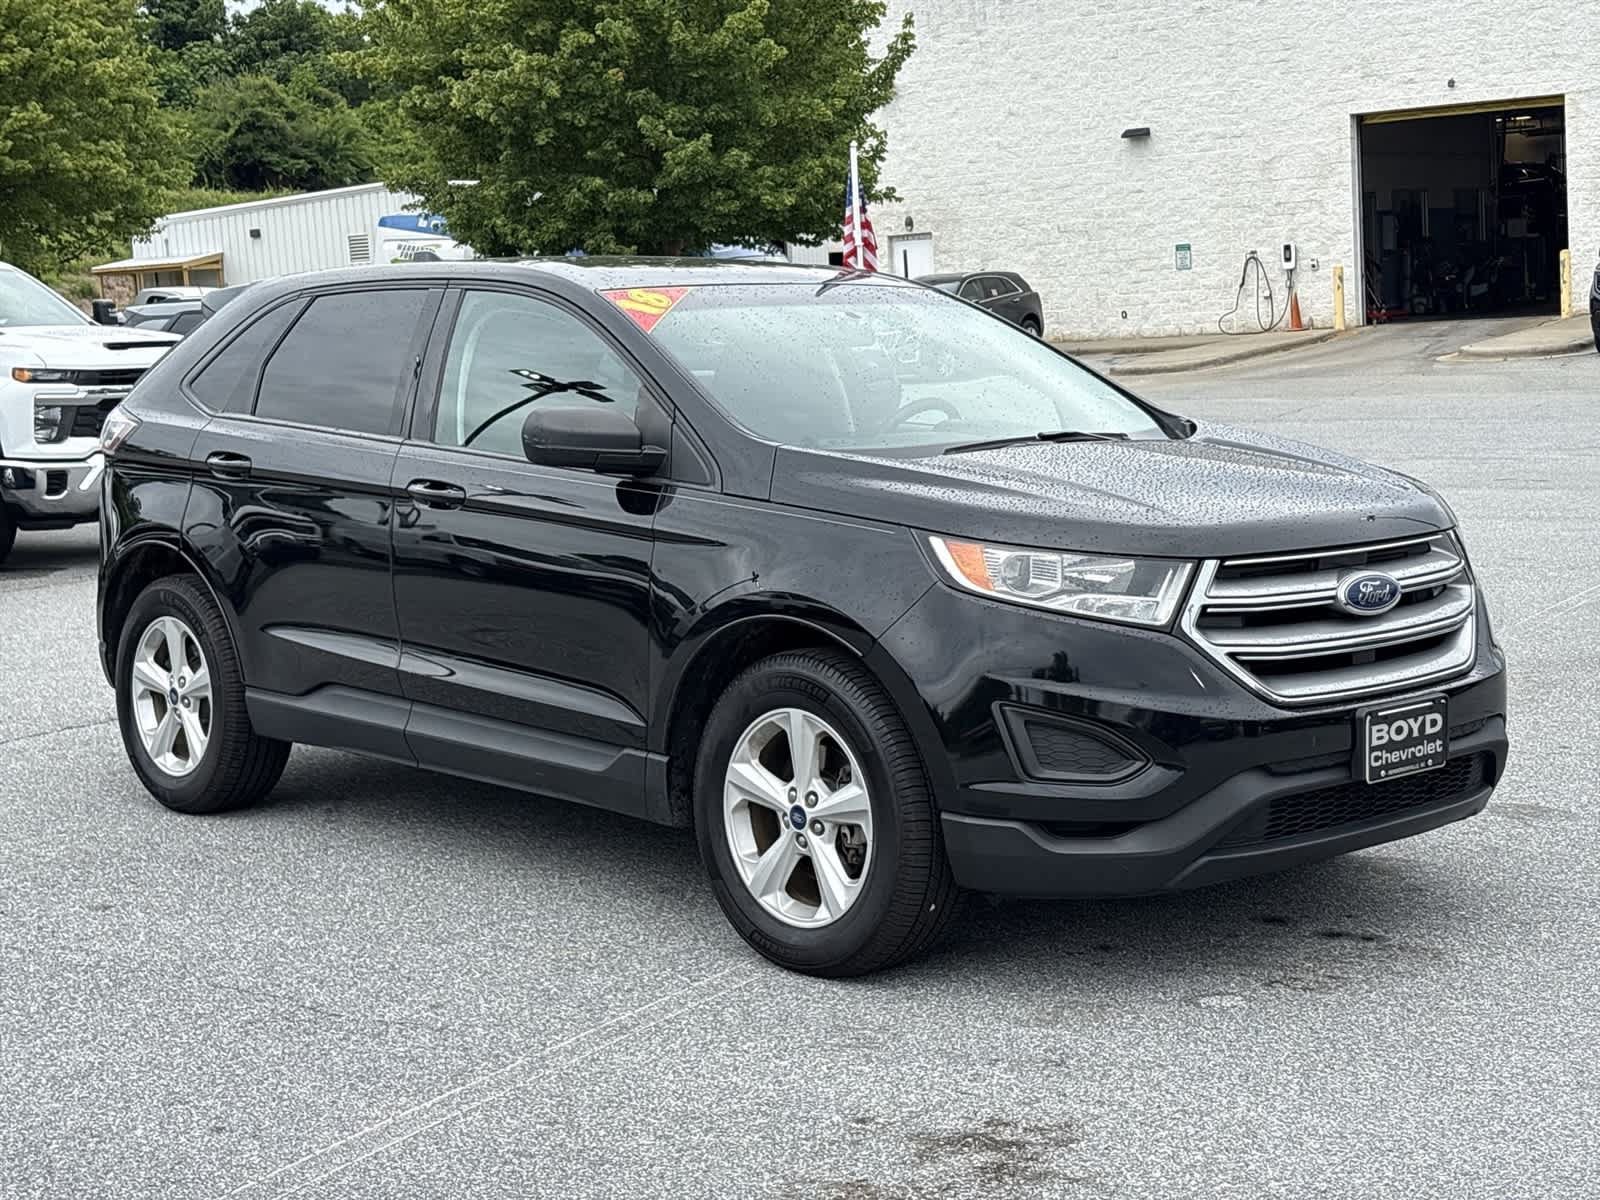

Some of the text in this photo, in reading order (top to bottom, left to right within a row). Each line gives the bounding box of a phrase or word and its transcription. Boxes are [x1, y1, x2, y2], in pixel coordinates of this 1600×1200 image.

[1359, 581, 1390, 605] Ford
[1370, 712, 1443, 747] BOYD
[1370, 739, 1443, 767] Chevrolet
